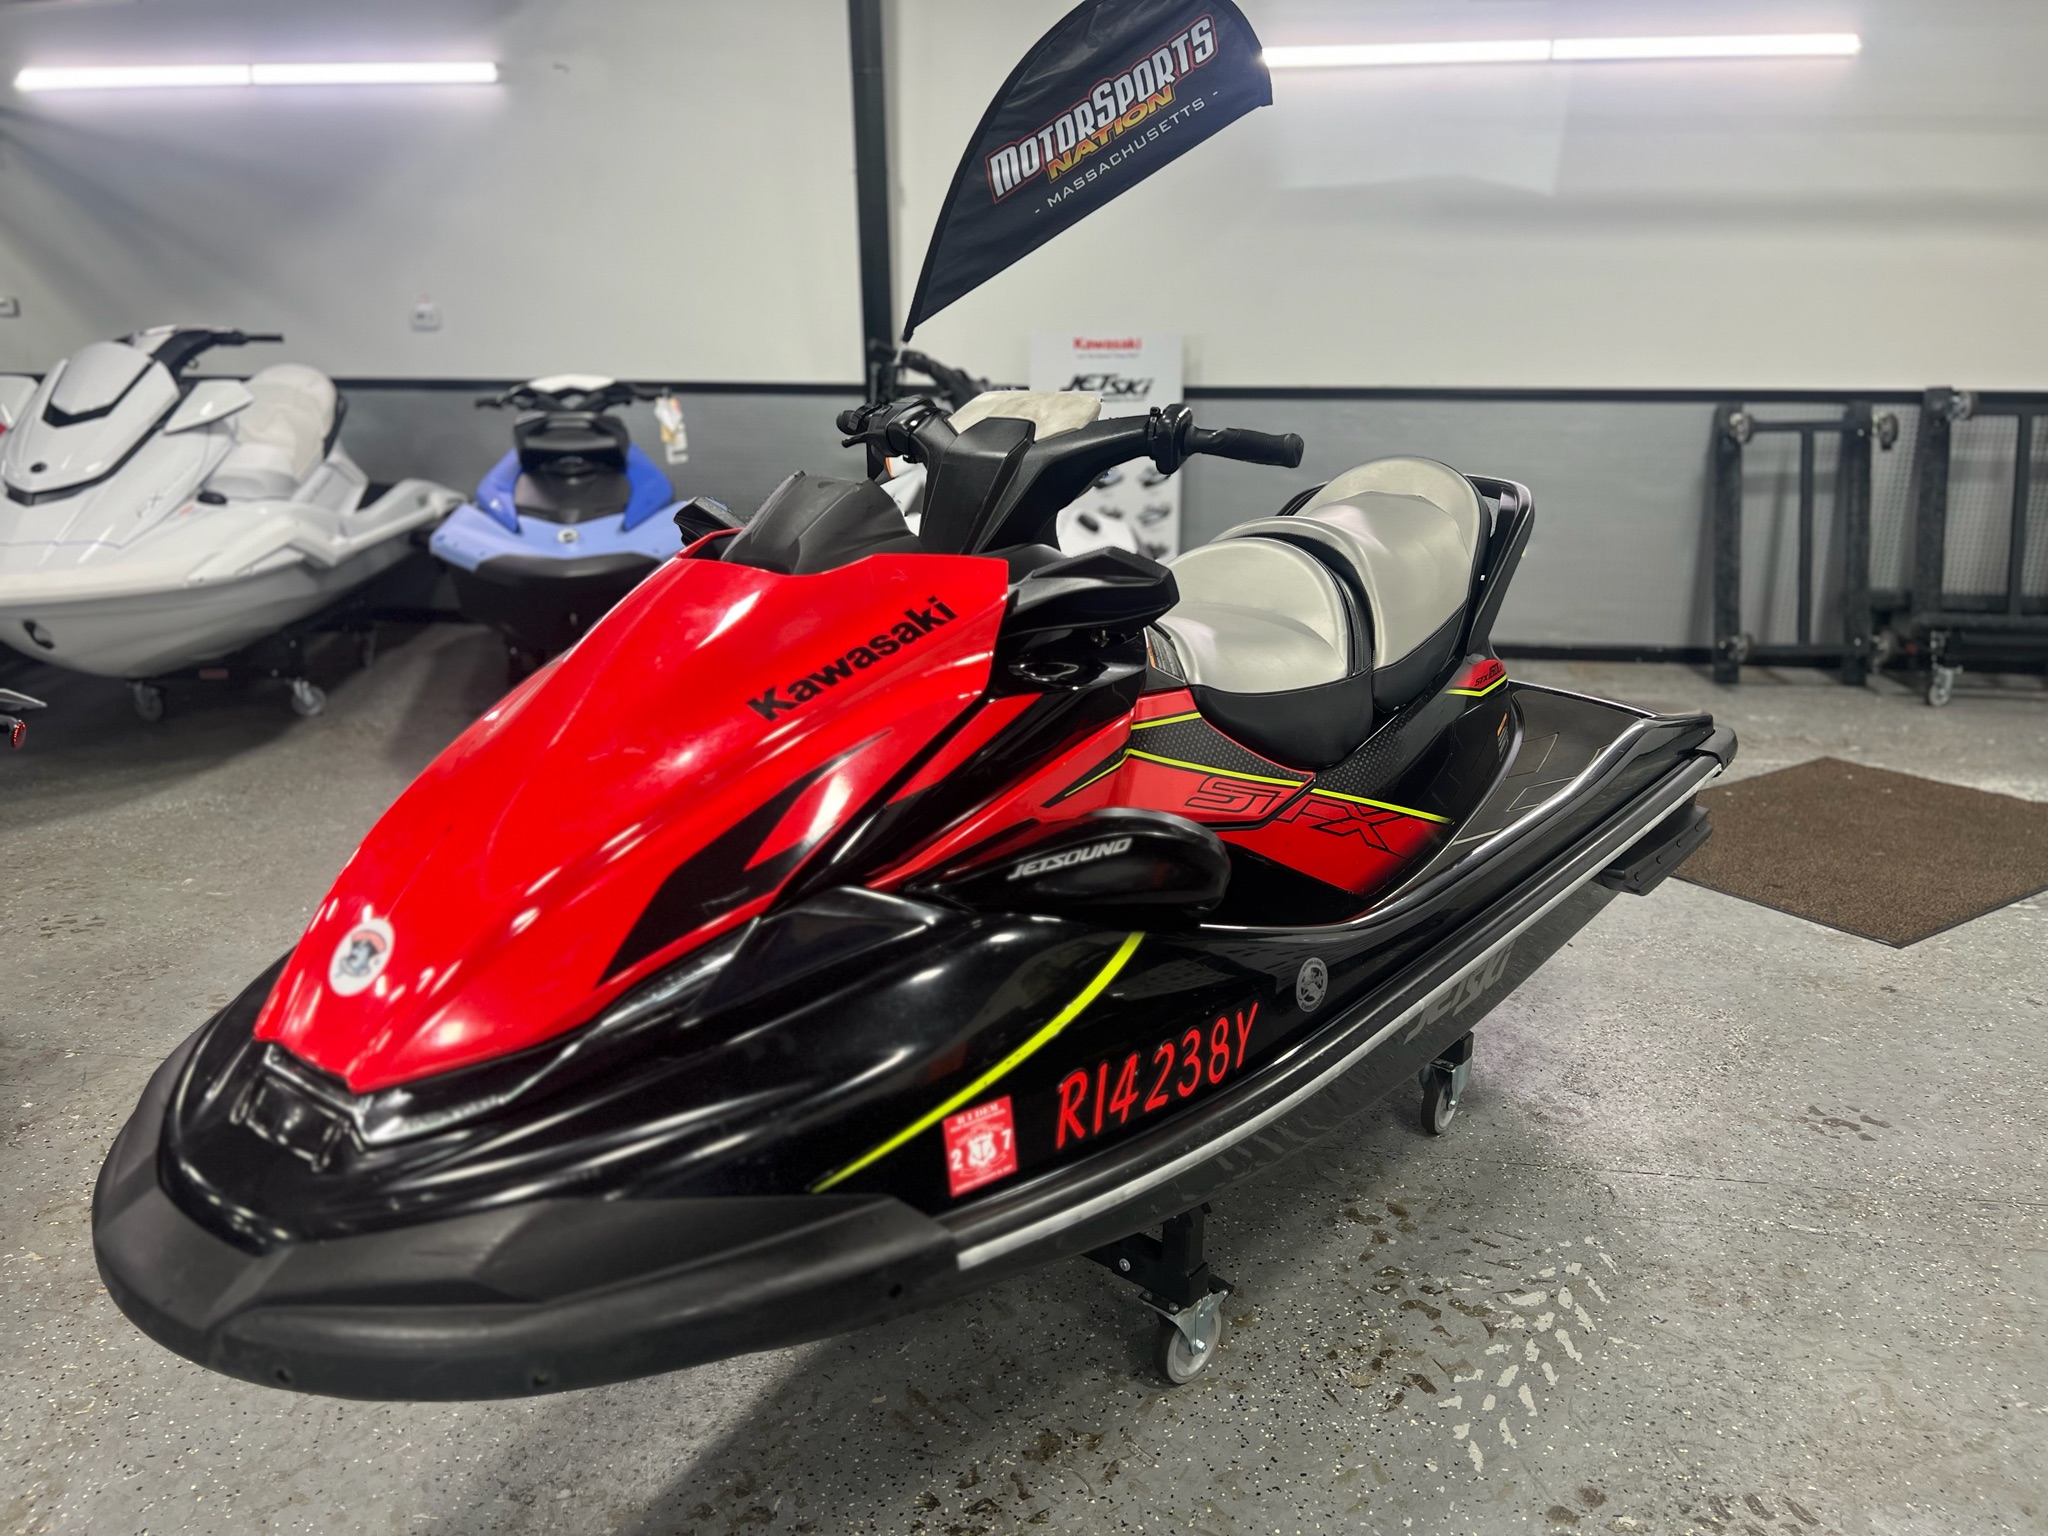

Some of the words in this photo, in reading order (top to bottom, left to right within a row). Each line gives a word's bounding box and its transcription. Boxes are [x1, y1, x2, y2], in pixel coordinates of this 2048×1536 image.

[988, 17, 1216, 199] MOTORSPORTS
[1047, 85, 1174, 182] NATION
[1047, 97, 1206, 209] MASSACHUSETTS
[747, 596, 958, 722] Kawasaki
[1007, 838, 1133, 880] JETSOUND
[950, 1148, 963, 1171] 2
[1001, 1128, 1011, 1151] 7
